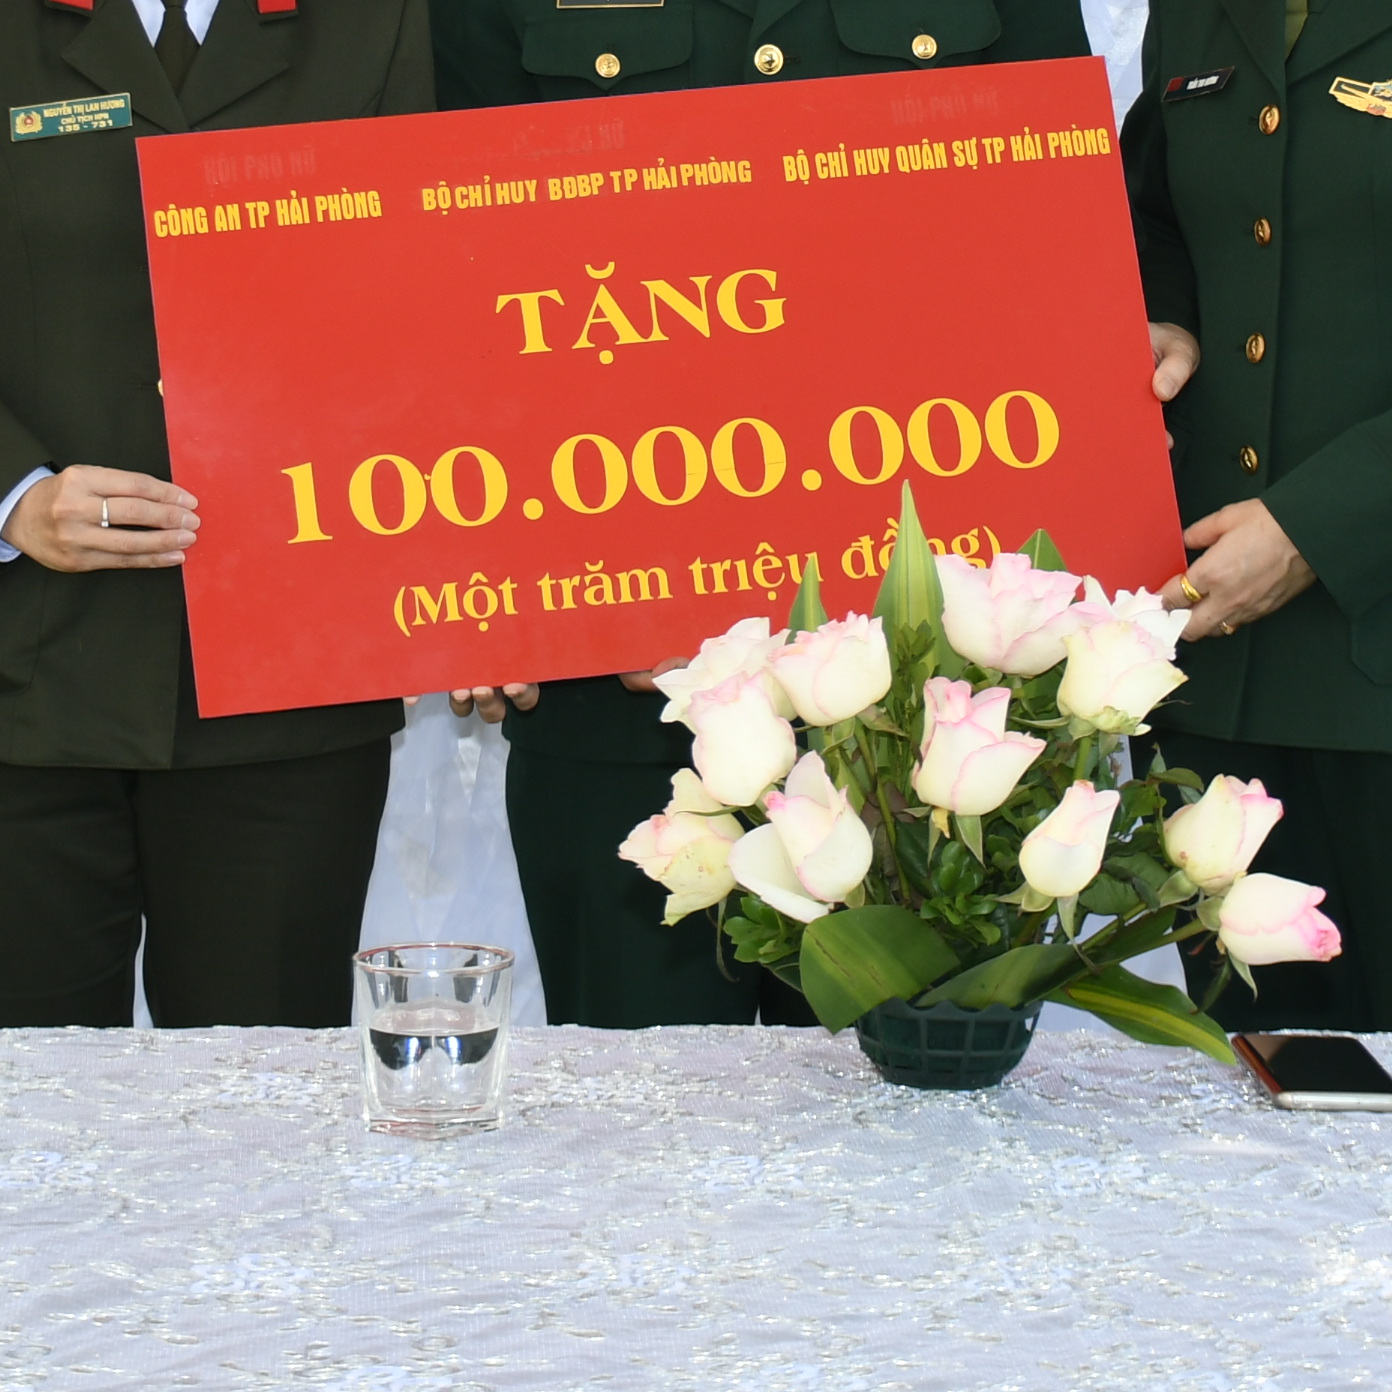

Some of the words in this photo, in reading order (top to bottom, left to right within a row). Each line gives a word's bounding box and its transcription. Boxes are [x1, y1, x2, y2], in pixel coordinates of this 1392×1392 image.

[422, 181, 452, 215] BỘ
[454, 176, 492, 208] CHỈ
[496, 180, 538, 205] HUY
[548, 173, 605, 201] BĐBP
[610, 169, 638, 194] TP
[643, 158, 678, 191] HẢI
[680, 156, 752, 186] PHÒNG
[783, 149, 809, 185] BỘ
[815, 143, 848, 180] CHỈ
[853, 148, 890, 176] HUY
[896, 139, 948, 173] QUÂN
[952, 137, 979, 171] SỰ
[982, 136, 1006, 164] TP
[1010, 126, 1043, 161] HẢI
[1047, 125, 1111, 158] PHÒNG
[154, 204, 208, 238] CÔNG
[215, 204, 242, 231] AN
[245, 202, 270, 228] TP
[276, 190, 310, 226] HẢI
[315, 187, 382, 223] PHÒNG
[496, 262, 787, 365] TẶNG
[281, 391, 1060, 545] 100.000.000
[394, 571, 518, 637] (Một
[537, 560, 673, 611] trăm
